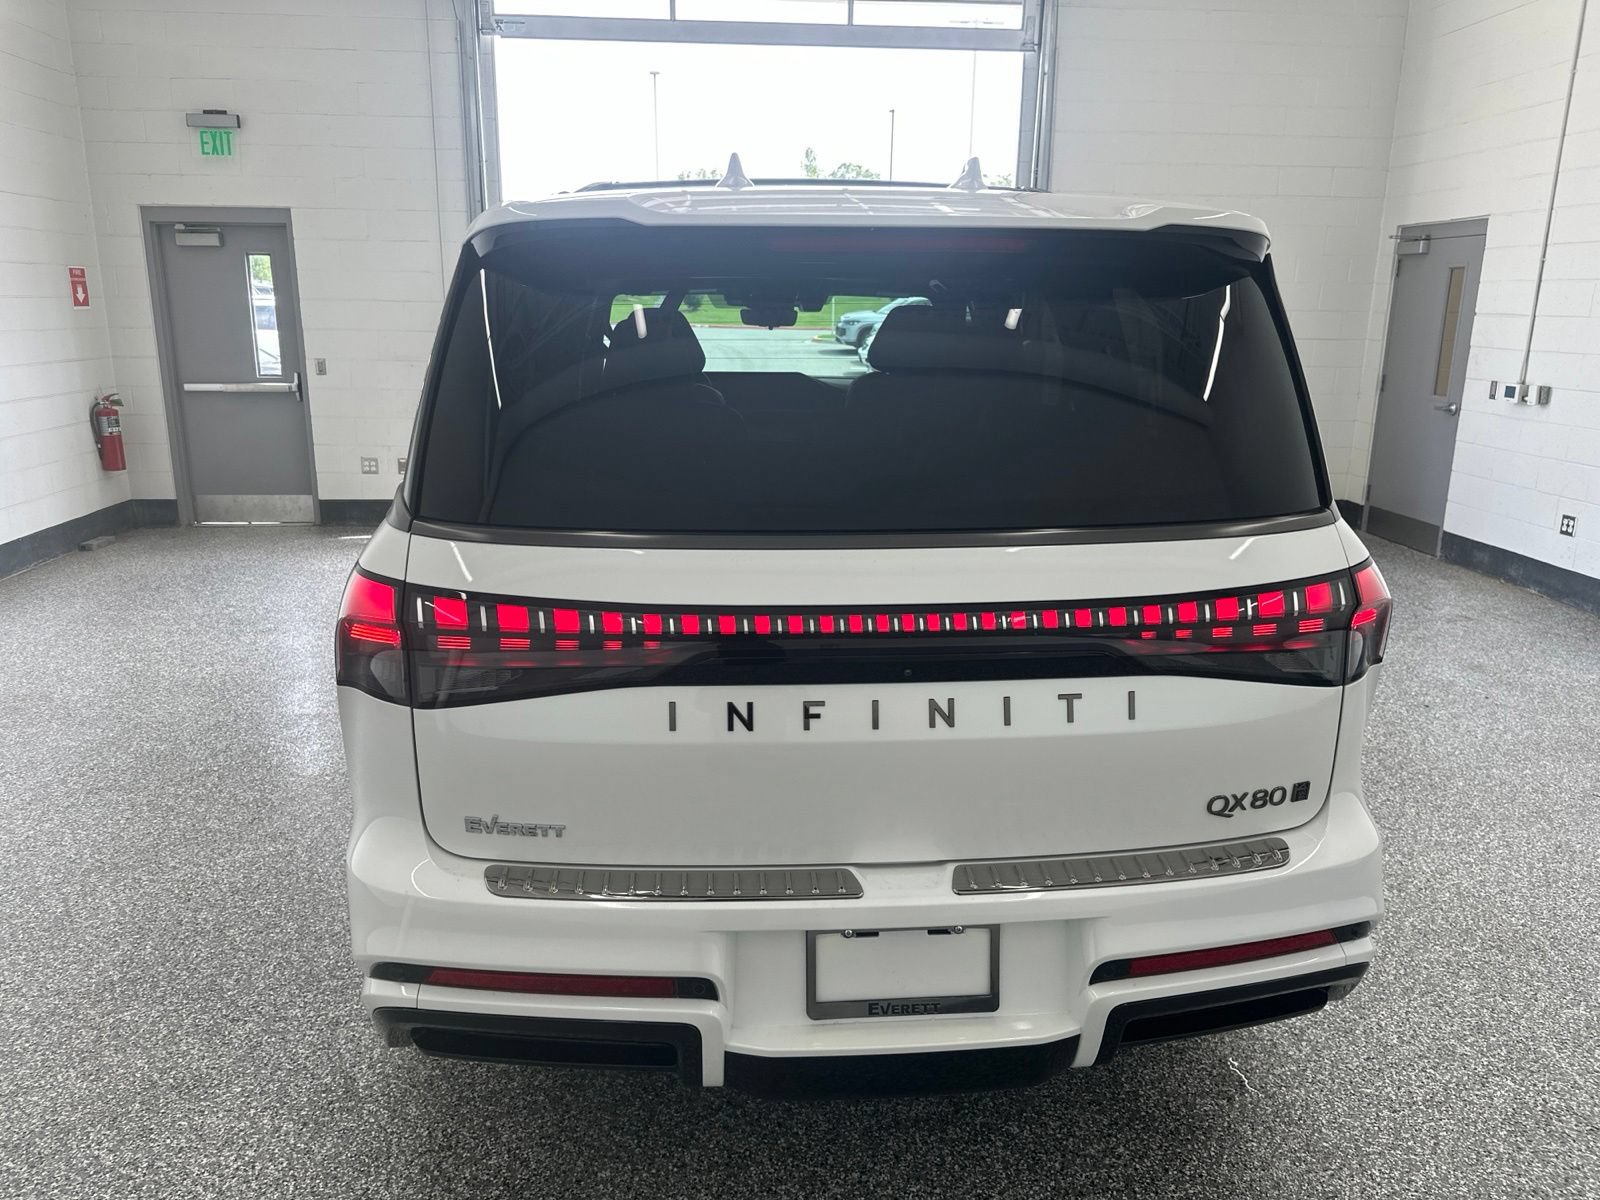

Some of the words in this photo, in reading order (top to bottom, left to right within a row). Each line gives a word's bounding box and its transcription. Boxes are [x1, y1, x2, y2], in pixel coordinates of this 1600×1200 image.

[200, 130, 232, 155] EXIT
[668, 690, 1136, 732] INFINITI
[1206, 786, 1287, 818] QX80
